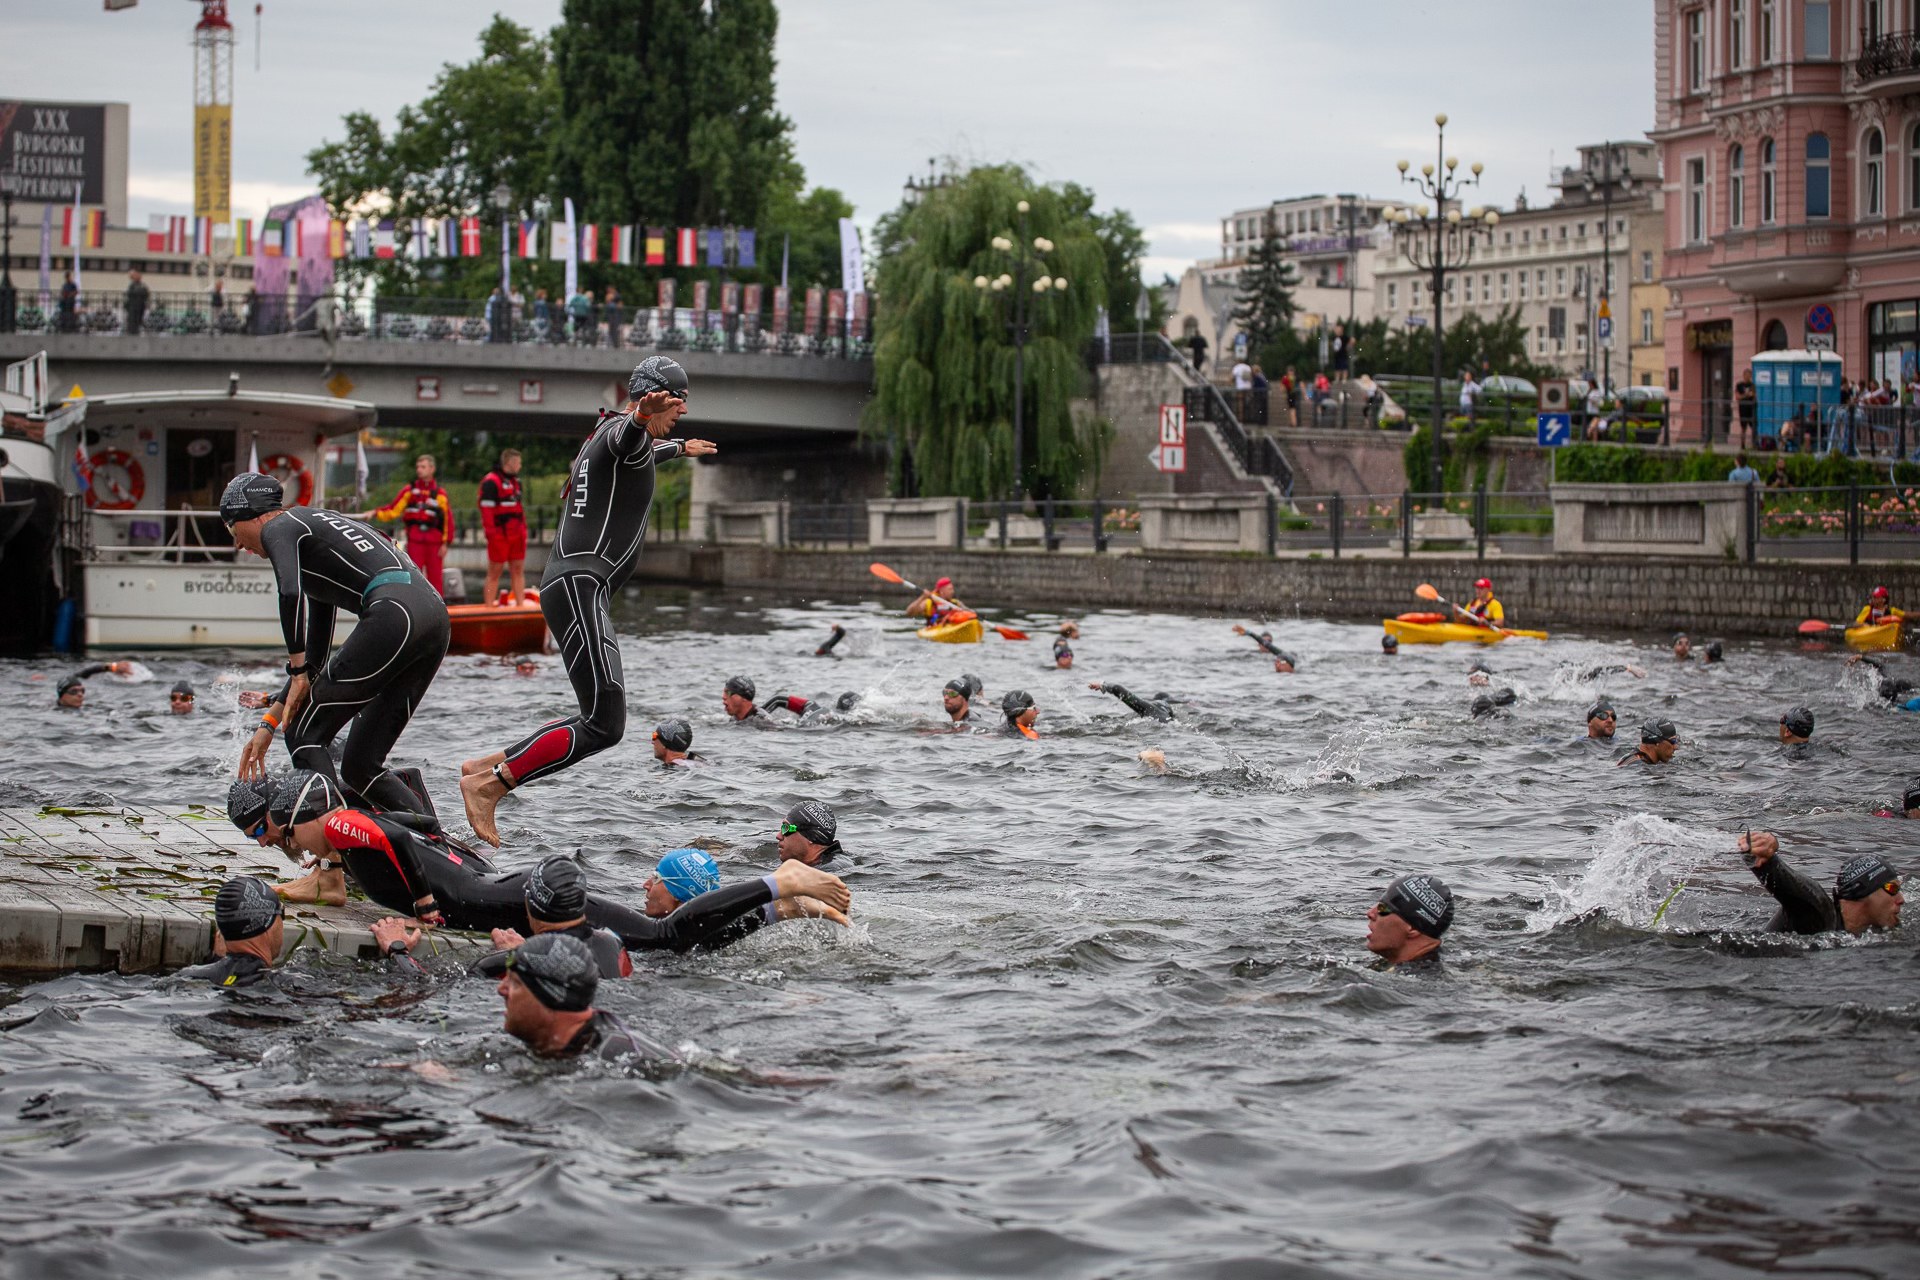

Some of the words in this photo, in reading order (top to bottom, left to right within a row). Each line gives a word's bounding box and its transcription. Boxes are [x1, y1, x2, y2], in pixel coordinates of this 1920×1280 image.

[33, 108, 69, 132] XXX
[13, 130, 85, 154] BYDGOSKI
[13, 152, 83, 176] FESTIWAL
[1601, 318, 1609, 335] P
[571, 458, 590, 518] HUUB
[312, 512, 375, 553] HUUB
[183, 581, 272, 594] BYDGOSZCZ
[1407, 880, 1442, 914] TRIATHLON
